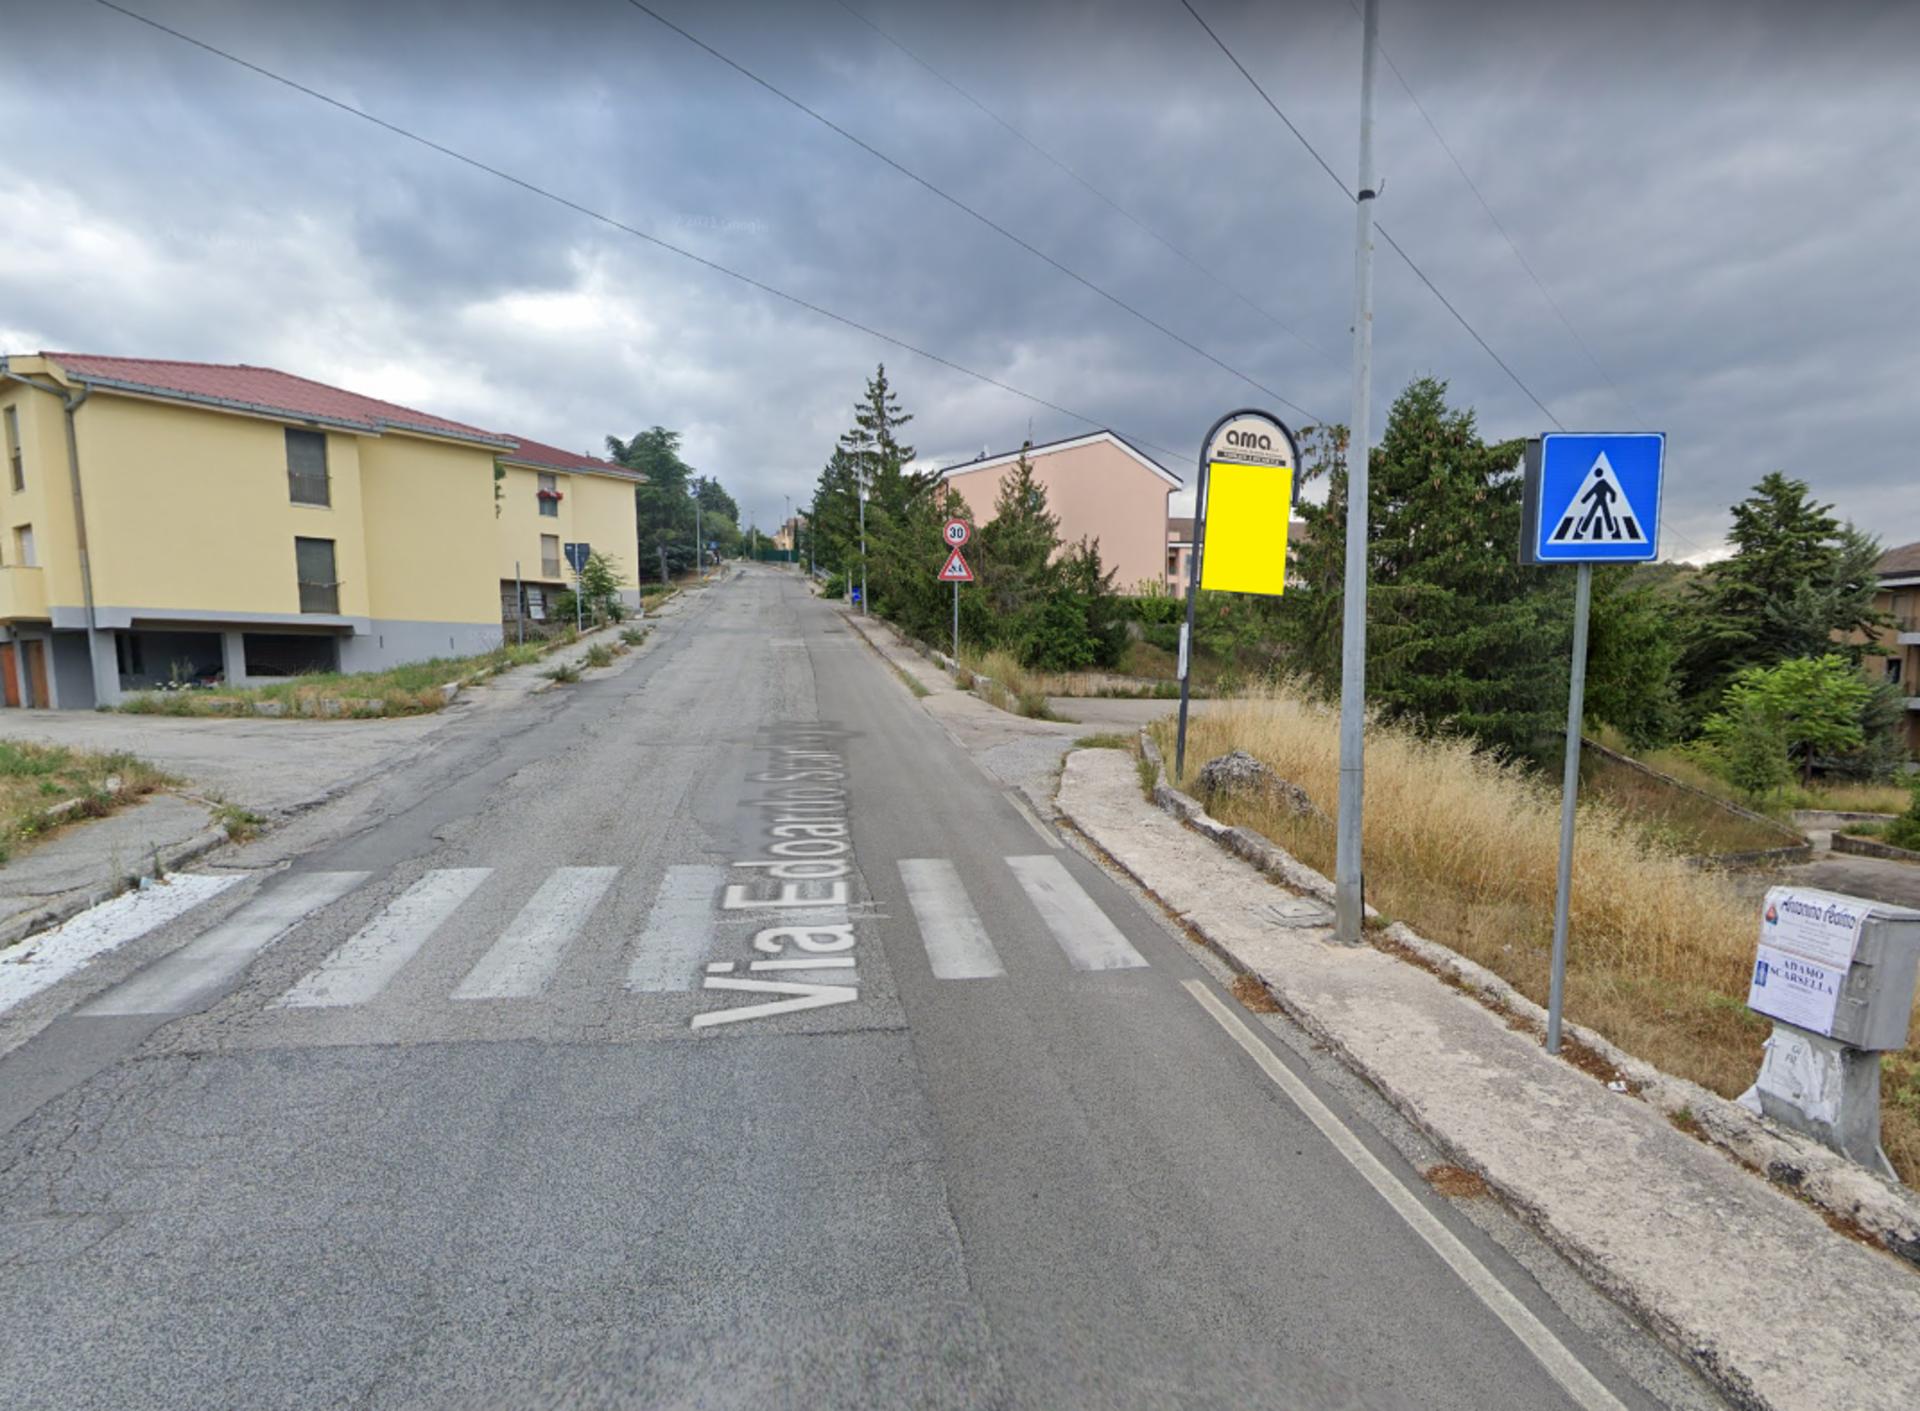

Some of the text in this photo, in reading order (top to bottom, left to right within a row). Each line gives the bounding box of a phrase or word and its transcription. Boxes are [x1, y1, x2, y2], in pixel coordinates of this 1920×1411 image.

[1226, 430, 1271, 450] ama
[949, 526, 964, 539] 30
[1784, 960, 1824, 980] ADAMO
[1770, 967, 1833, 995] SCARSELLA
